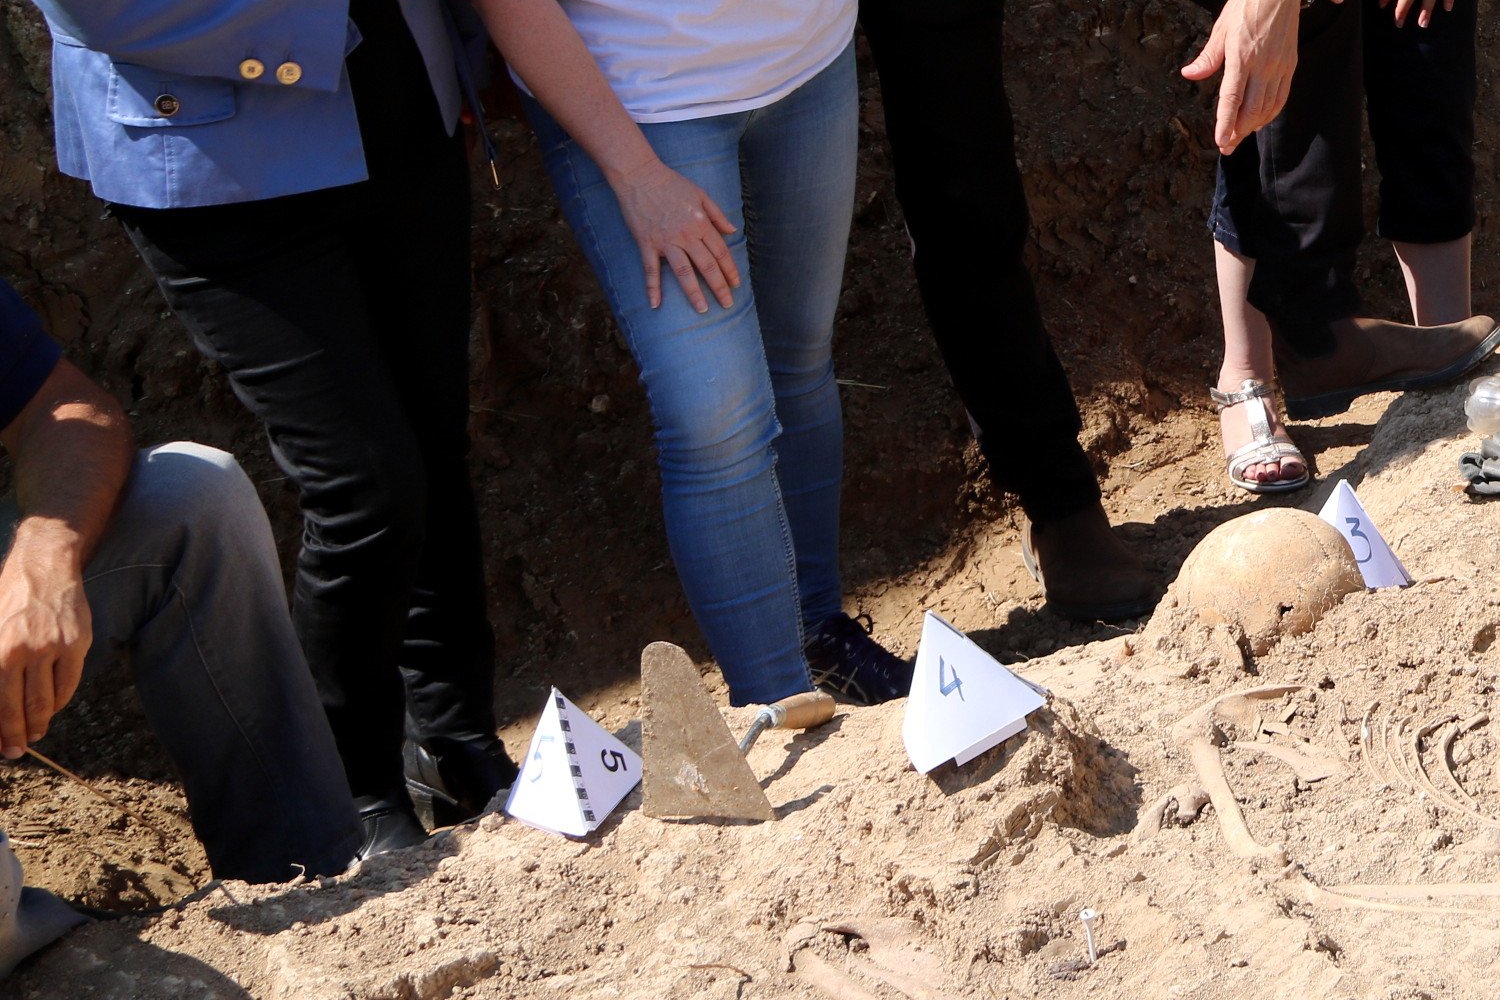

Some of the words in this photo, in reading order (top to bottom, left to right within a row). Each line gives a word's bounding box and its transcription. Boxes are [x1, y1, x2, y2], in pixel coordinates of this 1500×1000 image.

[1345, 516, 1372, 564] 3
[939, 654, 965, 702] 4
[529, 735, 555, 783] 5
[600, 748, 628, 773] 5
